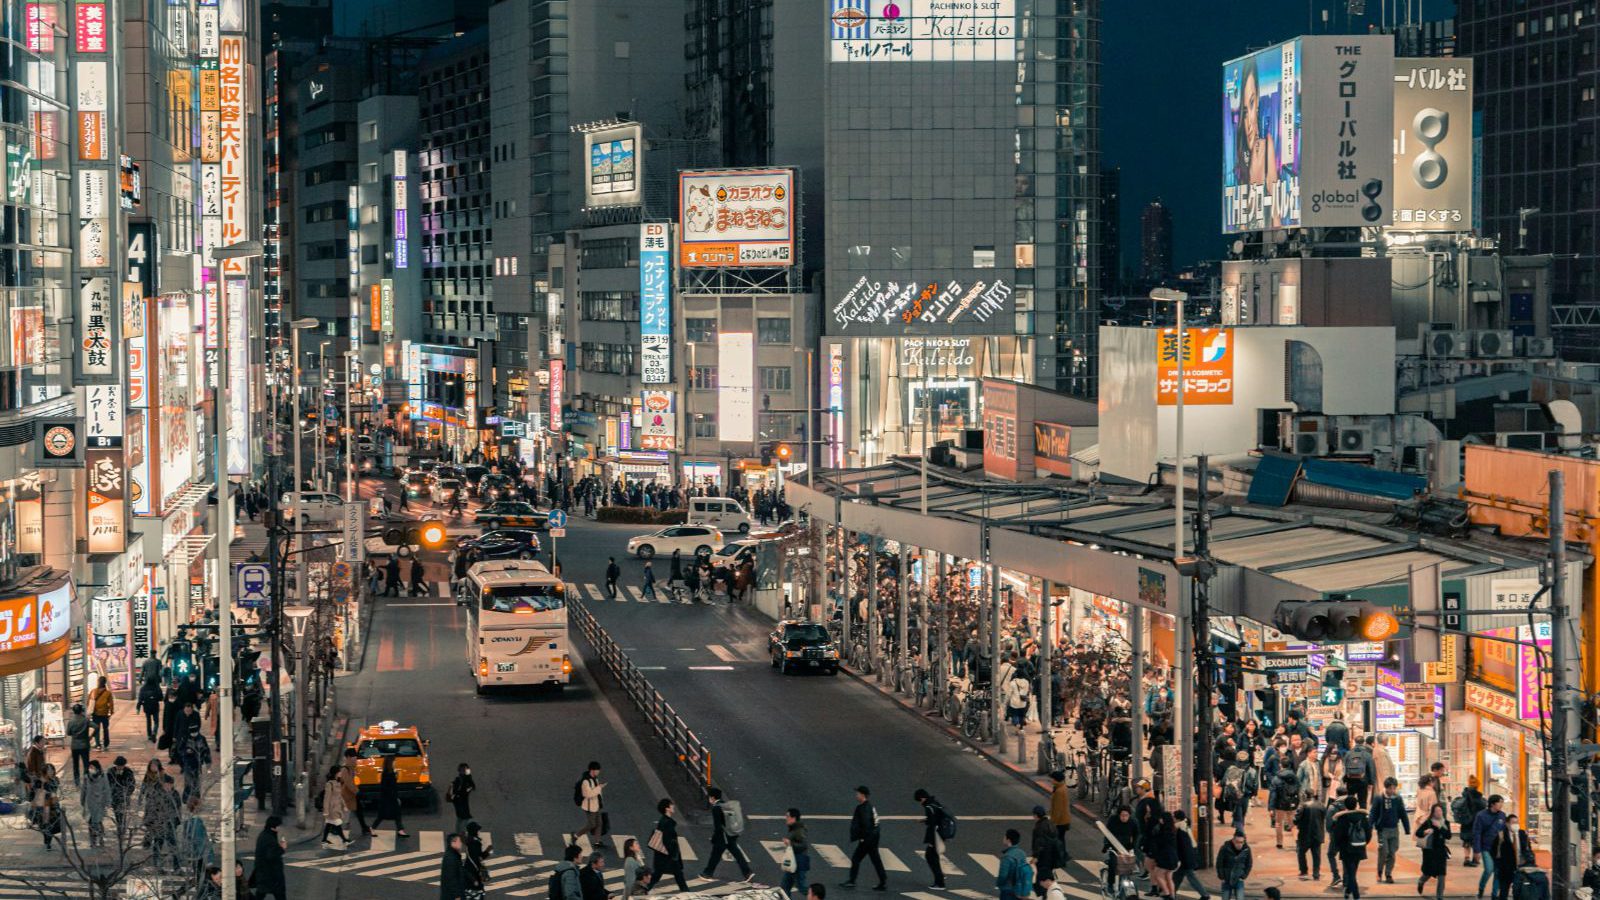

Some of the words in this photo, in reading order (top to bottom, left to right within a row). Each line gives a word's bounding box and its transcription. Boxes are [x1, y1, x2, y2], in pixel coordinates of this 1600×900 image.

[920, 15, 1010, 37] Kaleido
[1335, 46, 1362, 56] THE
[1338, 60, 1356, 180] グローバル社
[729, 186, 772, 200] カラオケ
[1312, 190, 1359, 213] global
[716, 209, 786, 232] まねきねこ
[648, 225, 663, 235] ED
[645, 237, 664, 248] 薄毛
[644, 261, 656, 325] クリニック
[655, 256, 668, 332] ユナイテッド
[953, 339, 971, 347] SLOT
[97, 436, 112, 446] B1
